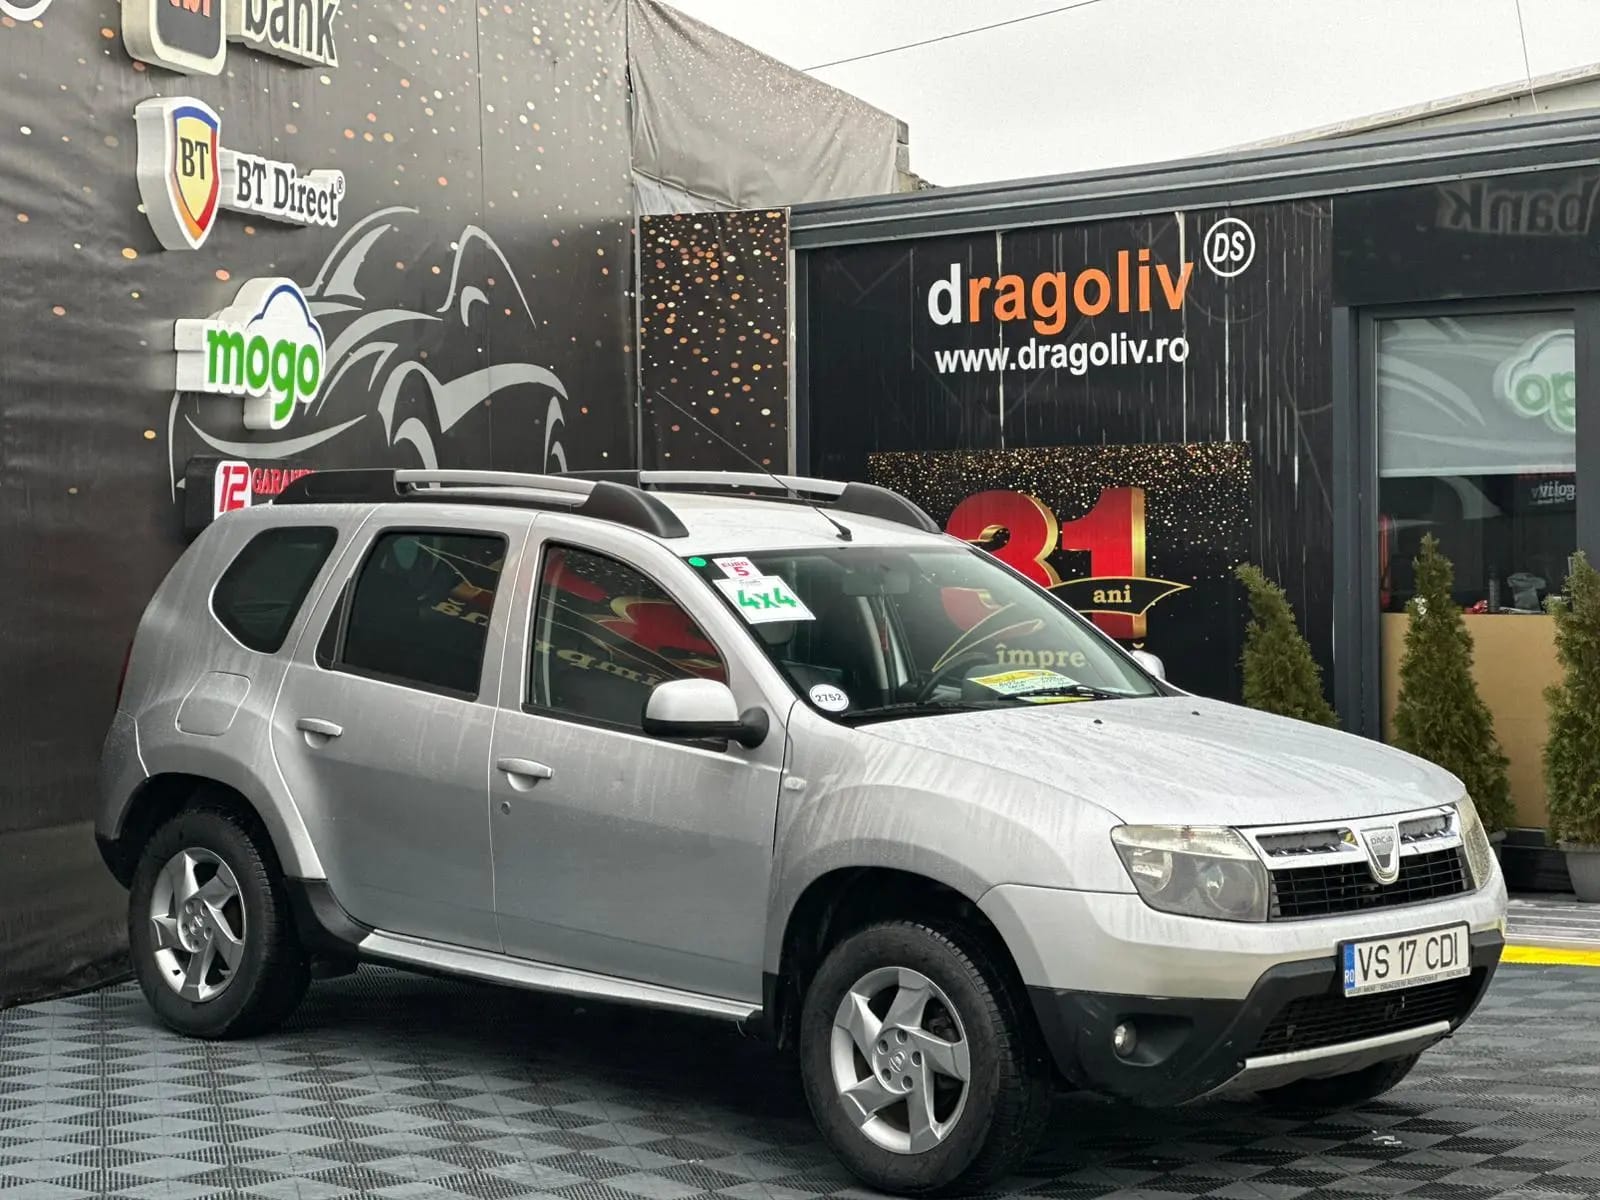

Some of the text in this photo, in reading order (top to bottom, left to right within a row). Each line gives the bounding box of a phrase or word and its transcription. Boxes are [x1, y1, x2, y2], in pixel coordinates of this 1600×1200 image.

[245, 0, 337, 60] bank
[180, 137, 209, 180] BT
[236, 159, 267, 205] BT
[1212, 230, 1246, 263] DS
[927, 248, 1194, 335] dragoliv
[207, 328, 320, 421] mogo
[934, 332, 1190, 376] www.dragoliv.ro
[219, 465, 250, 513] 12
[721, 560, 749, 568] EURO
[734, 566, 750, 577] 5
[945, 486, 1147, 640] 31
[1093, 584, 1132, 604] ani
[996, 642, 1086, 668] împre
[815, 692, 844, 703] 2752
[1344, 969, 1355, 984] RO
[1358, 931, 1458, 982] VS 17 CDI
